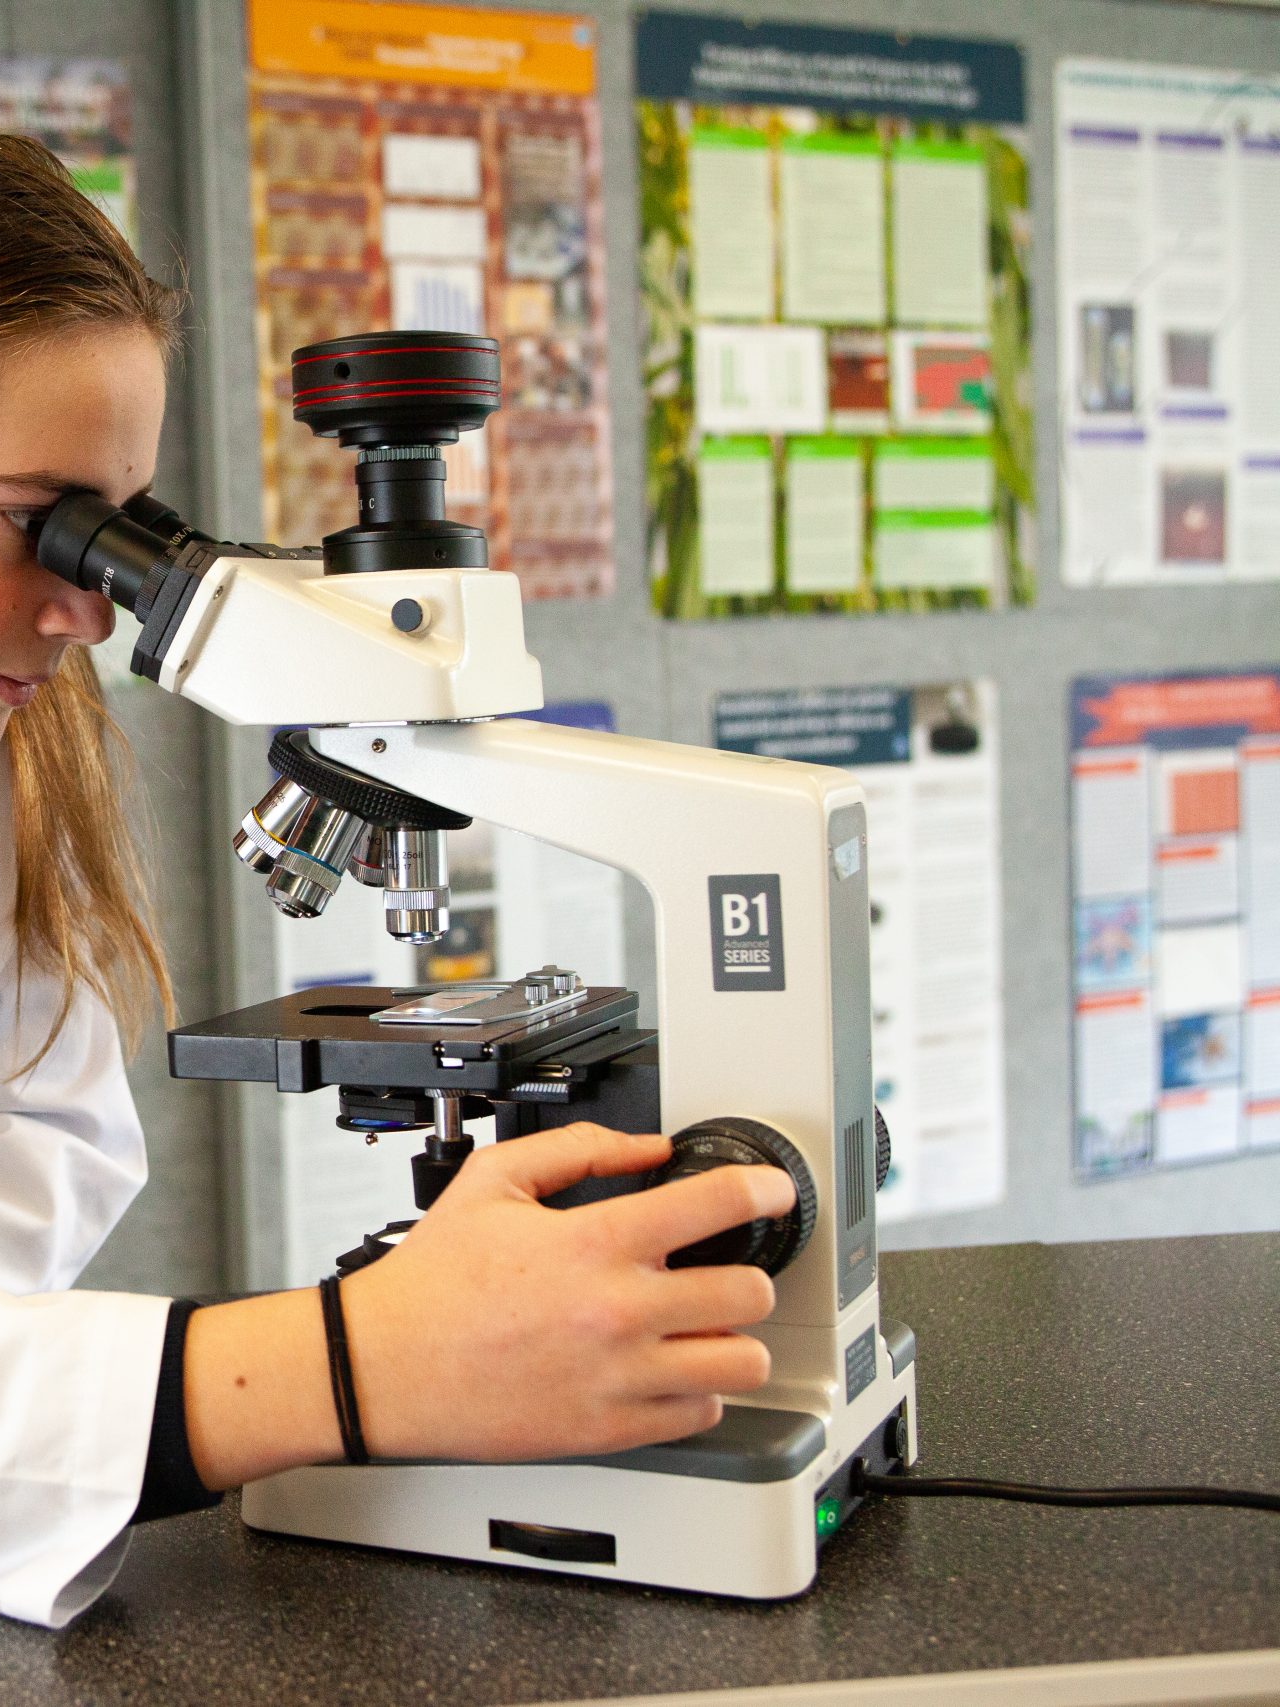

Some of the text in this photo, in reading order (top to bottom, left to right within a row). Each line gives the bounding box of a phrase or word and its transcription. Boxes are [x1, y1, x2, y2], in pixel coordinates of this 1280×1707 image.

[722, 892, 768, 936] B1
[724, 939, 769, 949] Advanced
[724, 949, 770, 963] SERIES
